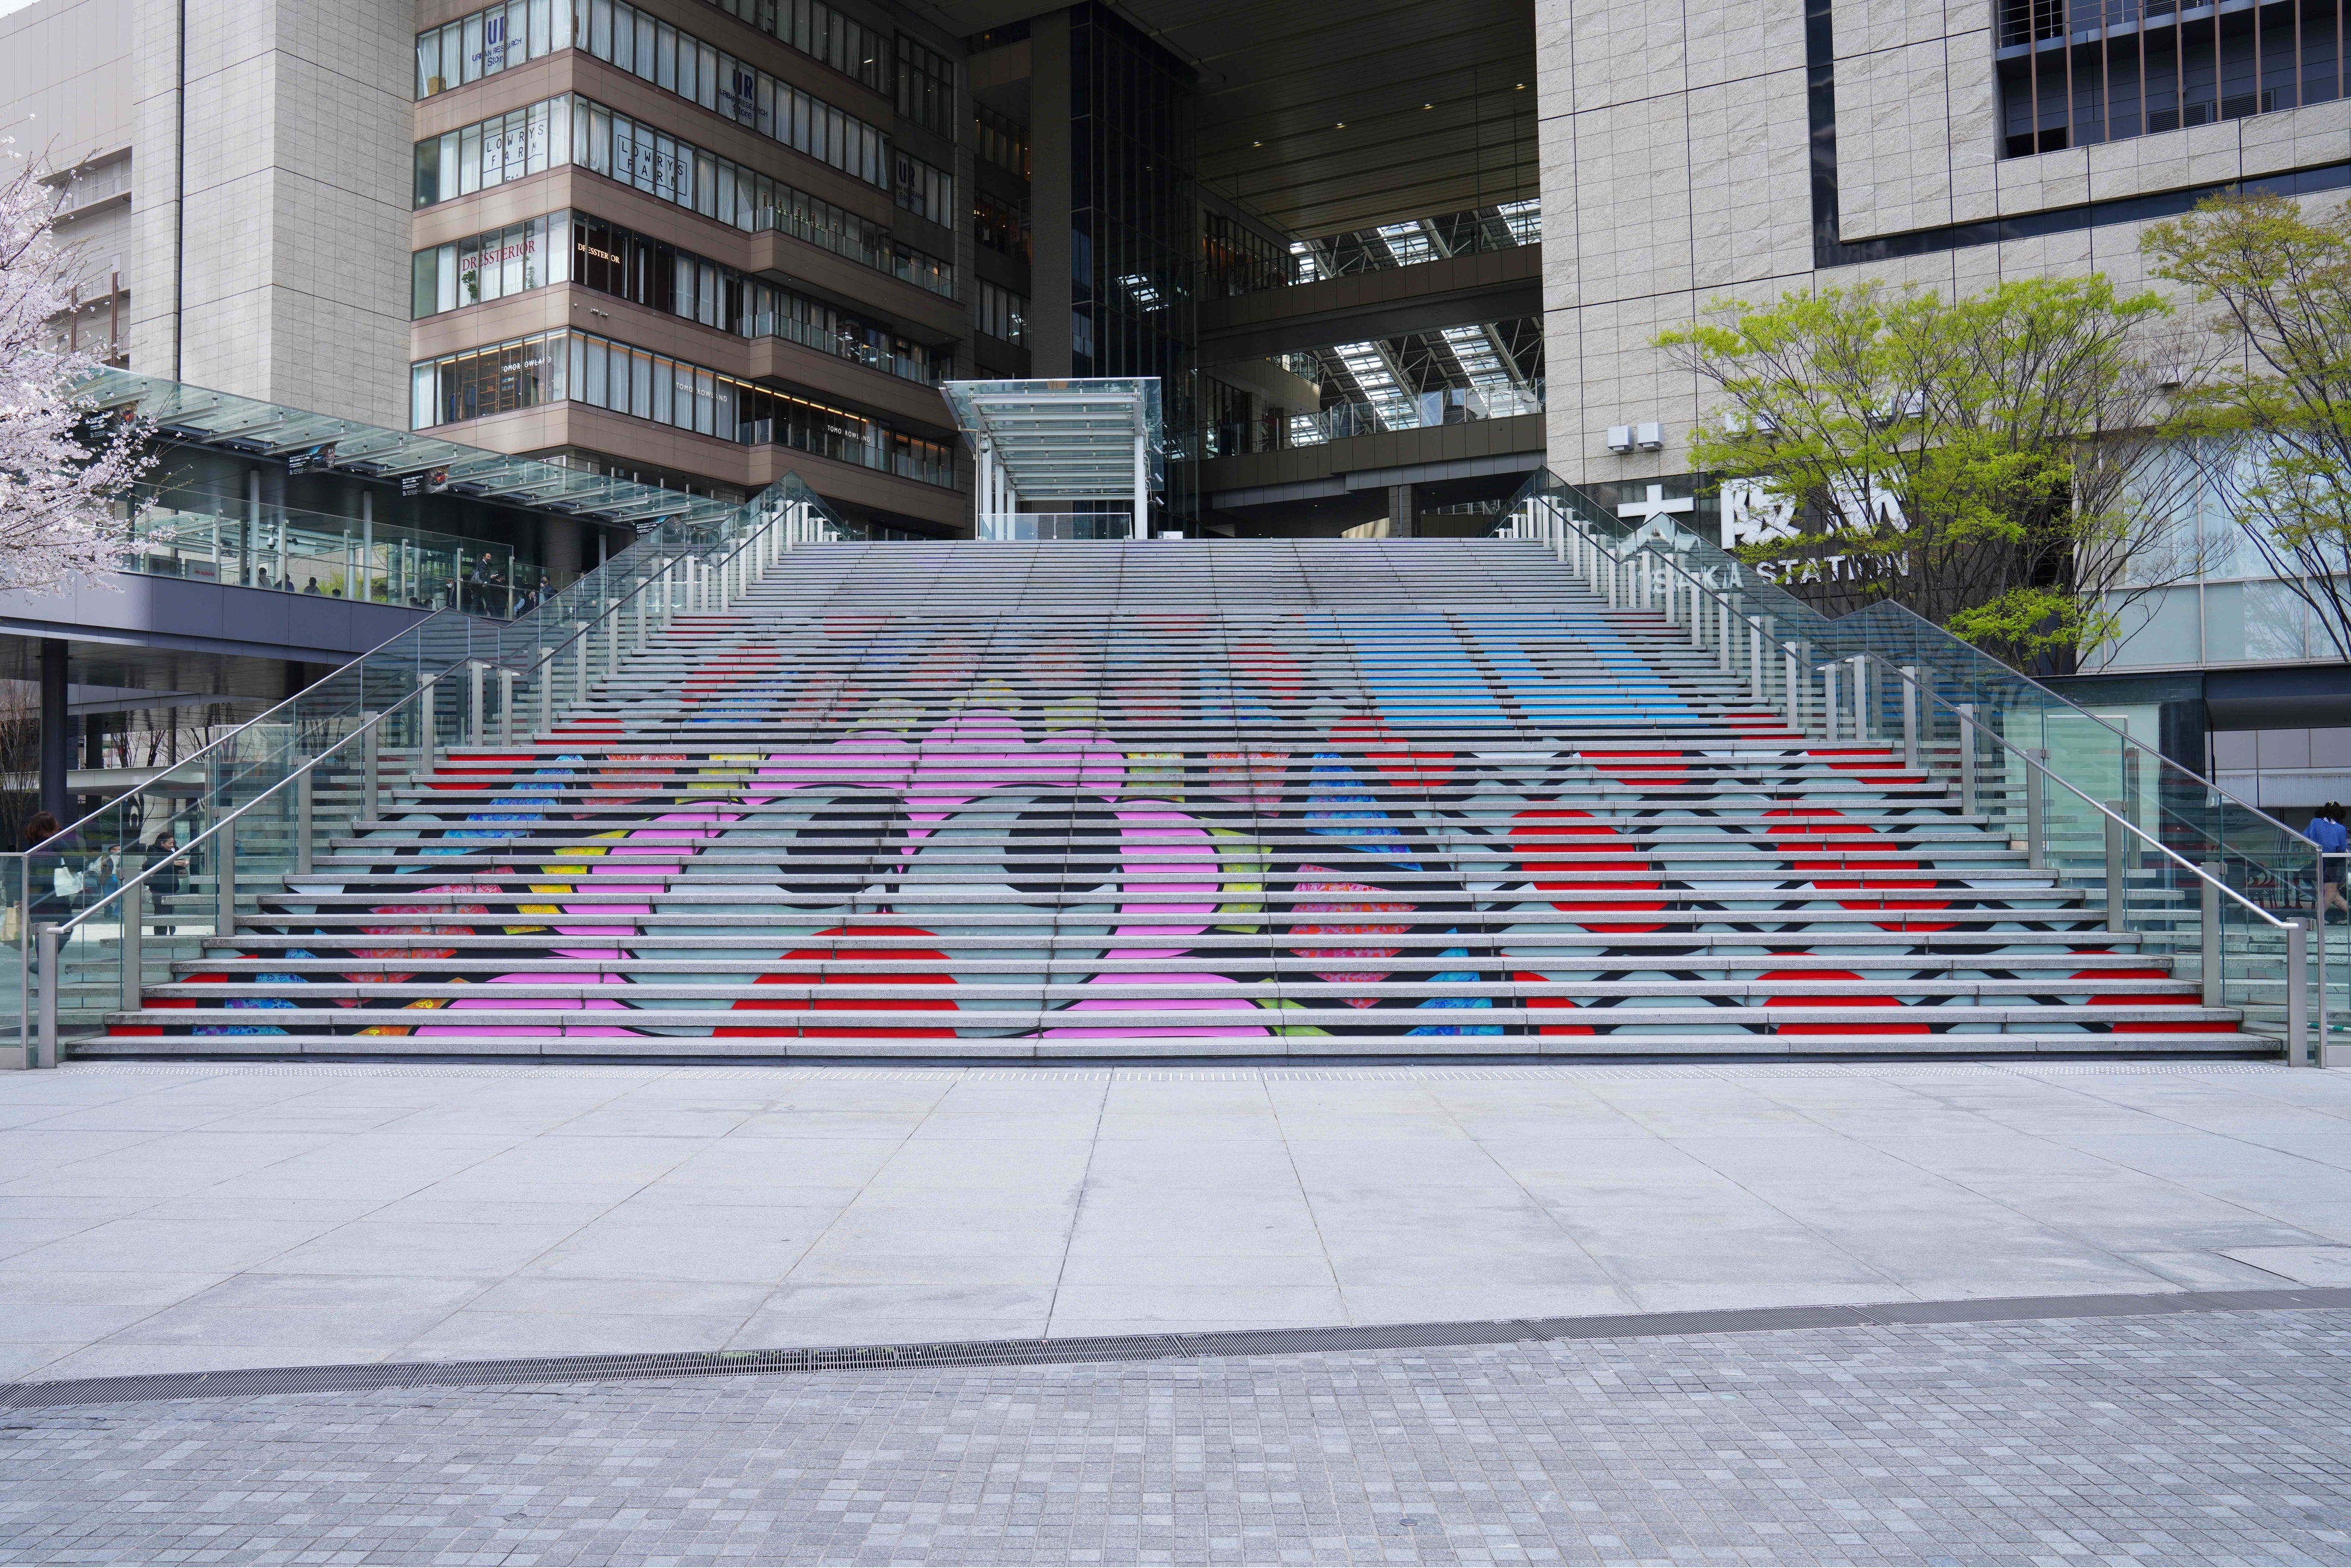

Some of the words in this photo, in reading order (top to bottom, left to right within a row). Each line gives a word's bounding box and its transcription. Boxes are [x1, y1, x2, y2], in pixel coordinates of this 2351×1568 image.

[488, 55, 504, 66] Stor
[732, 69, 753, 101] UR
[487, 124, 544, 153] LOWRYS
[492, 141, 537, 166] FARM
[622, 140, 683, 175] LOWRYS
[899, 192, 915, 205] Stoe
[462, 240, 535, 271] DRESSTERIOR
[578, 243, 620, 264] DRESSTEROR
[502, 356, 552, 373] OMOROWLAND
[676, 382, 728, 402] TOMOROWLND
[827, 424, 870, 442] TOMOROWLND
[1637, 561, 1745, 594] SAKA
